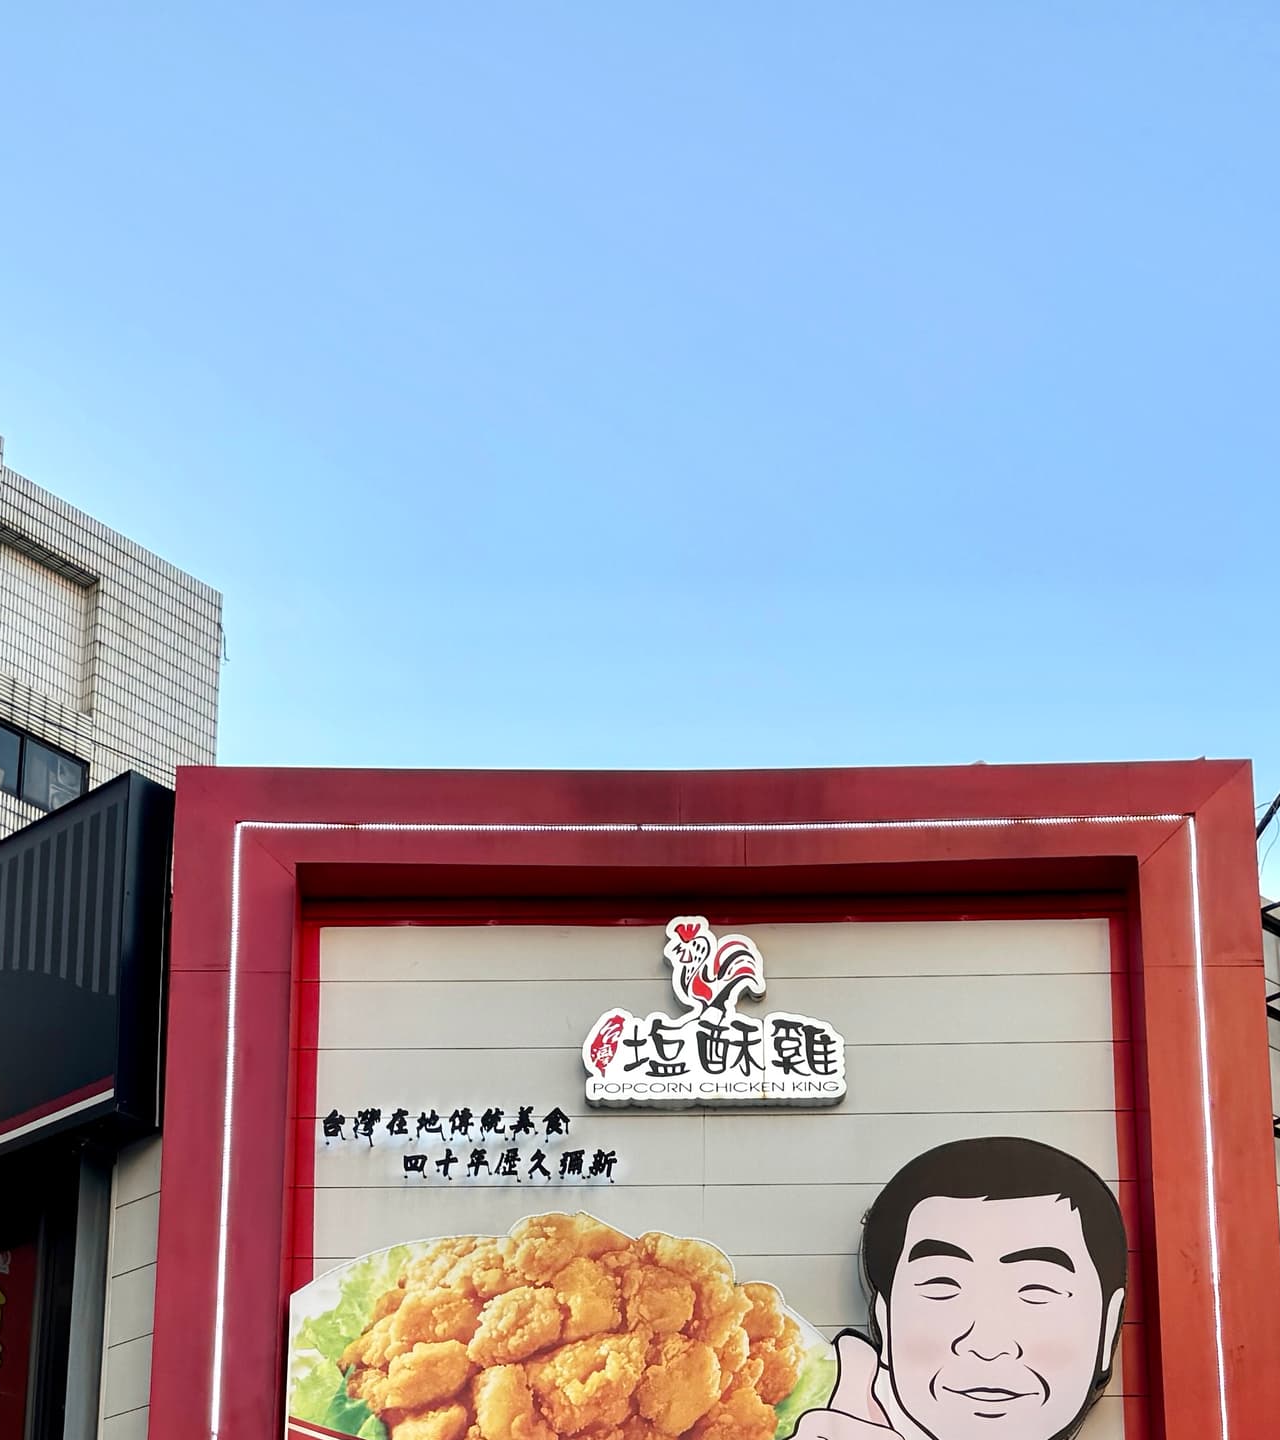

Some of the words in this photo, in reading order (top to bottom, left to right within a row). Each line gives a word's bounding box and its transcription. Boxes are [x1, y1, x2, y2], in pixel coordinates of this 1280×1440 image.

[624, 1017, 838, 1077] 塩酥雞
[593, 1082, 692, 1094] POPCORN
[699, 1082, 786, 1094] CHICKEN
[792, 1080, 840, 1093] KING
[323, 1107, 570, 1144] 台灣在地傳統美食
